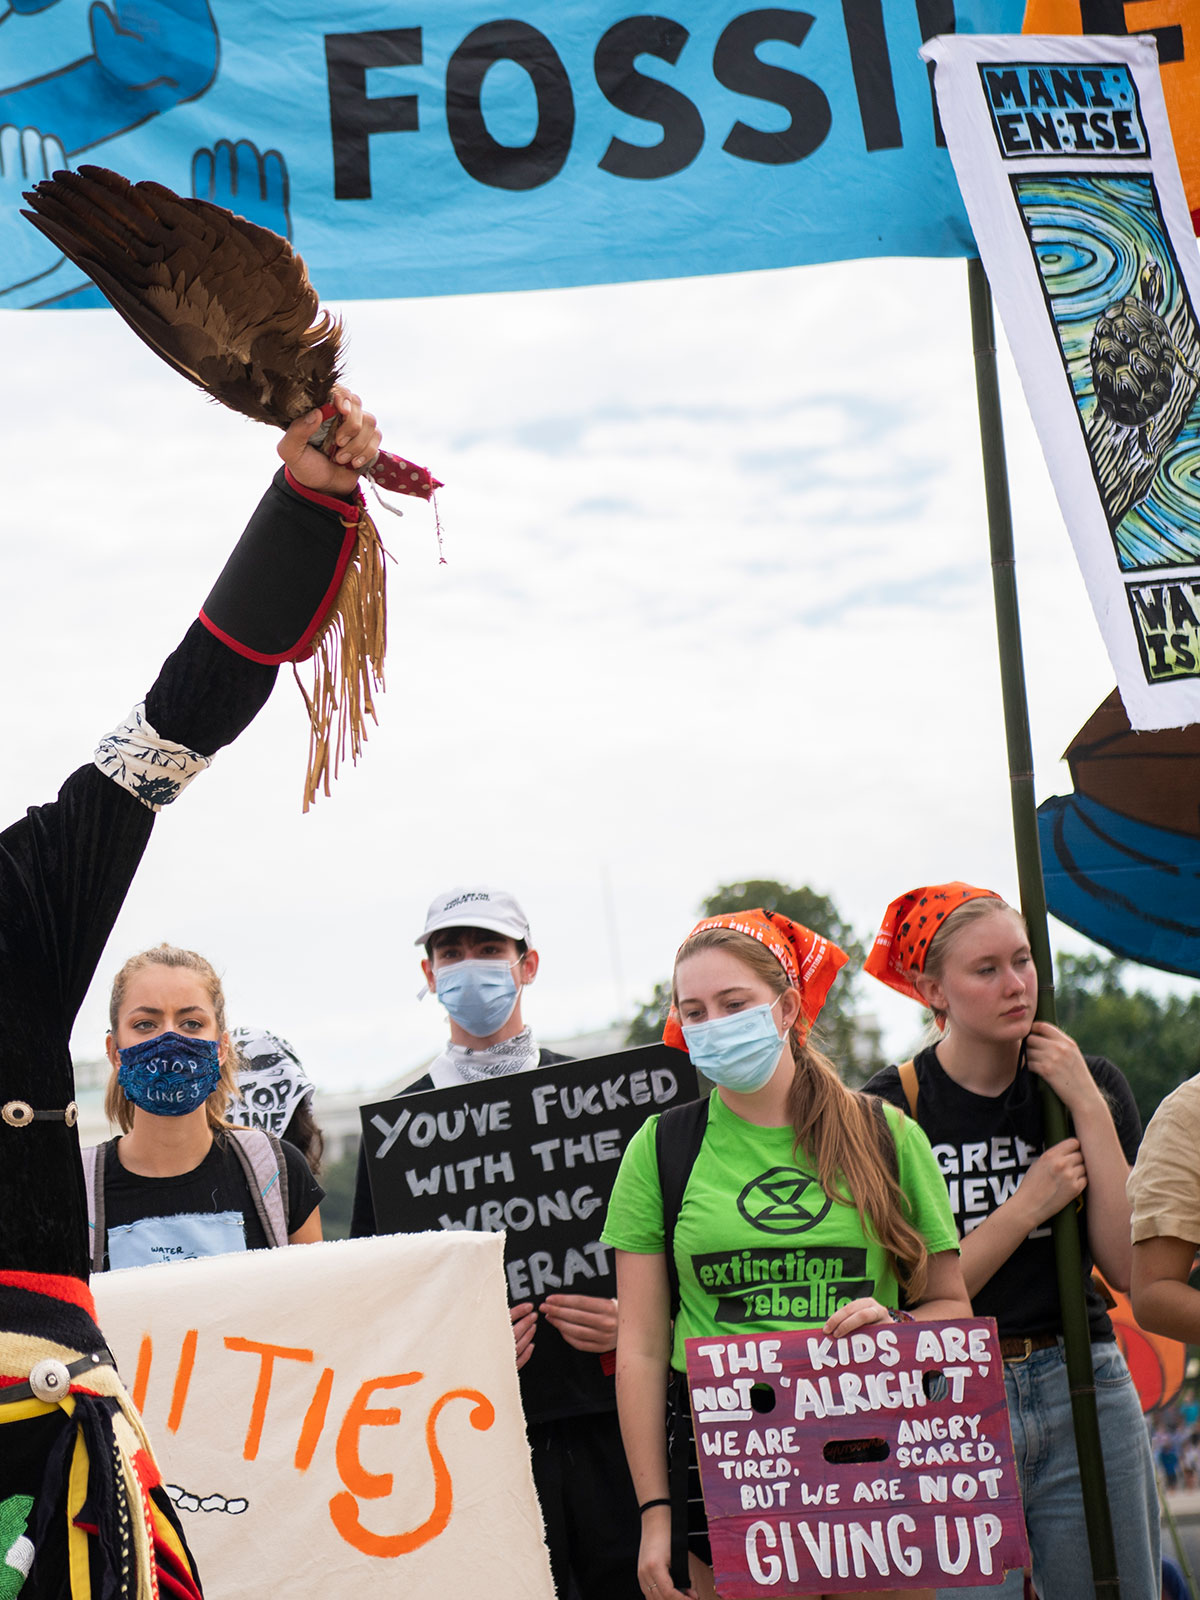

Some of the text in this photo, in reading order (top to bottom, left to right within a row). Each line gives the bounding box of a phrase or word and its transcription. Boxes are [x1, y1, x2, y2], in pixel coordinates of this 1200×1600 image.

[985, 67, 1131, 107] MANI:
[996, 110, 1141, 152] EN:ISE
[1131, 583, 1200, 630] WA
[1146, 633, 1196, 673] IS
[146, 1057, 198, 1074] STOP
[147, 1082, 200, 1103] LINE 3
[370, 1068, 679, 1160] YOU'VE FUCKED
[405, 1129, 622, 1198] WITH THE
[931, 1135, 1041, 1175] GREE
[438, 1185, 603, 1232] WRONG
[150, 1246, 185, 1255] WATER
[699, 1250, 844, 1287] extinction
[698, 1327, 992, 1378] THE KIDS ARE
[692, 1378, 755, 1413] NOT
[701, 1431, 741, 1457] WE
[745, 1426, 800, 1456] ARE
[897, 1414, 987, 1445] ANGRY,
[896, 1442, 1002, 1469] SCARED,
[740, 1468, 1004, 1510] BUT WE ARE NOT
[745, 1513, 1002, 1586] GIVING UP
